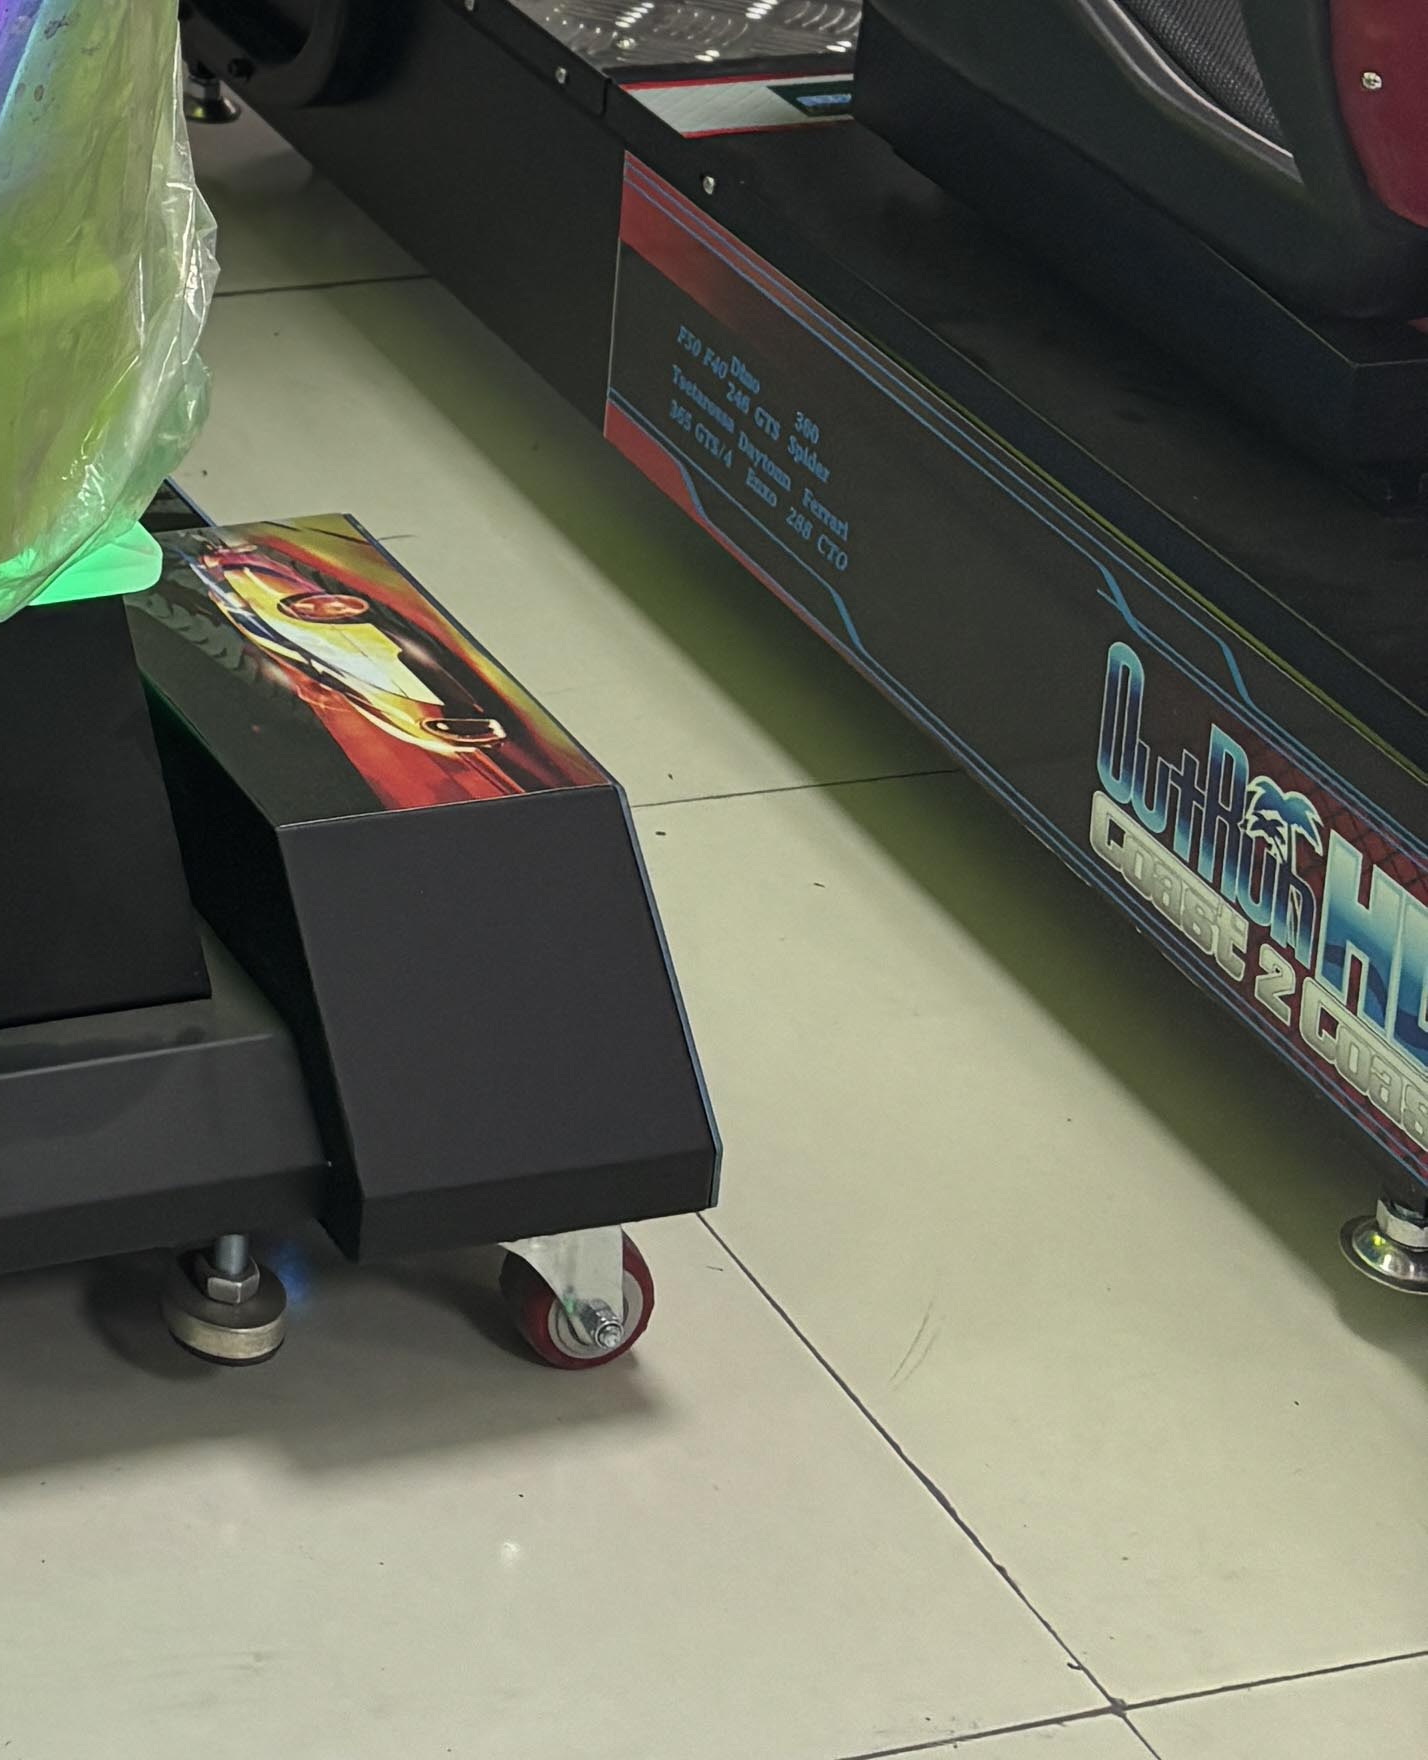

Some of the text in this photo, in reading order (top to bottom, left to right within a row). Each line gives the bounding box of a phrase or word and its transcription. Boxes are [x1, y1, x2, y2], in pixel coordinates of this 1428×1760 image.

[1090, 791, 1249, 981] Coast
[1255, 944, 1295, 1028] 2
[1097, 642, 1321, 971] OutRun
